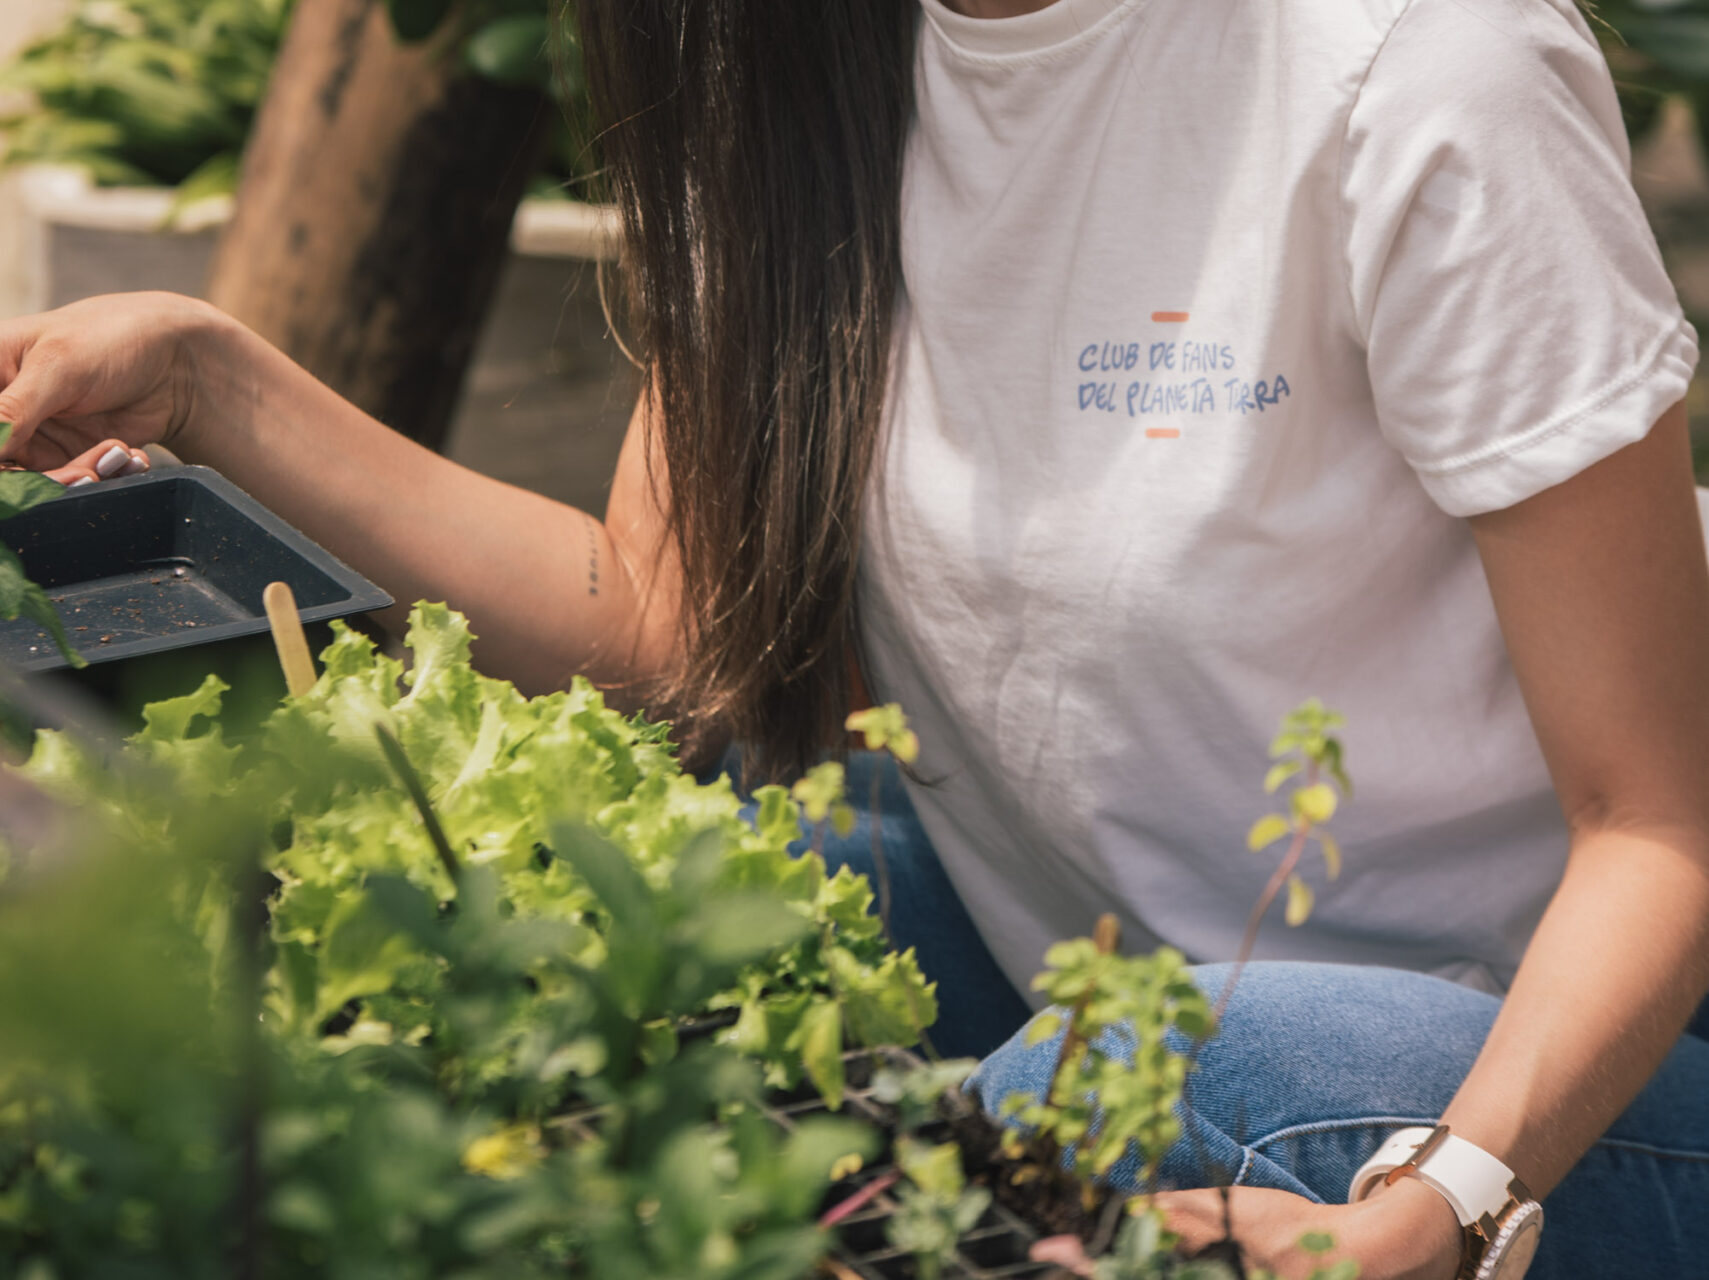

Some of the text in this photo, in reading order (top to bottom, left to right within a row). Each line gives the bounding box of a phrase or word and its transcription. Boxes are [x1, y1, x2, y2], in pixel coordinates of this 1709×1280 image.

[1078, 340, 1235, 373] CLUB DE FANS
[1078, 374, 1290, 417] DEL PLANETA TIRRA
